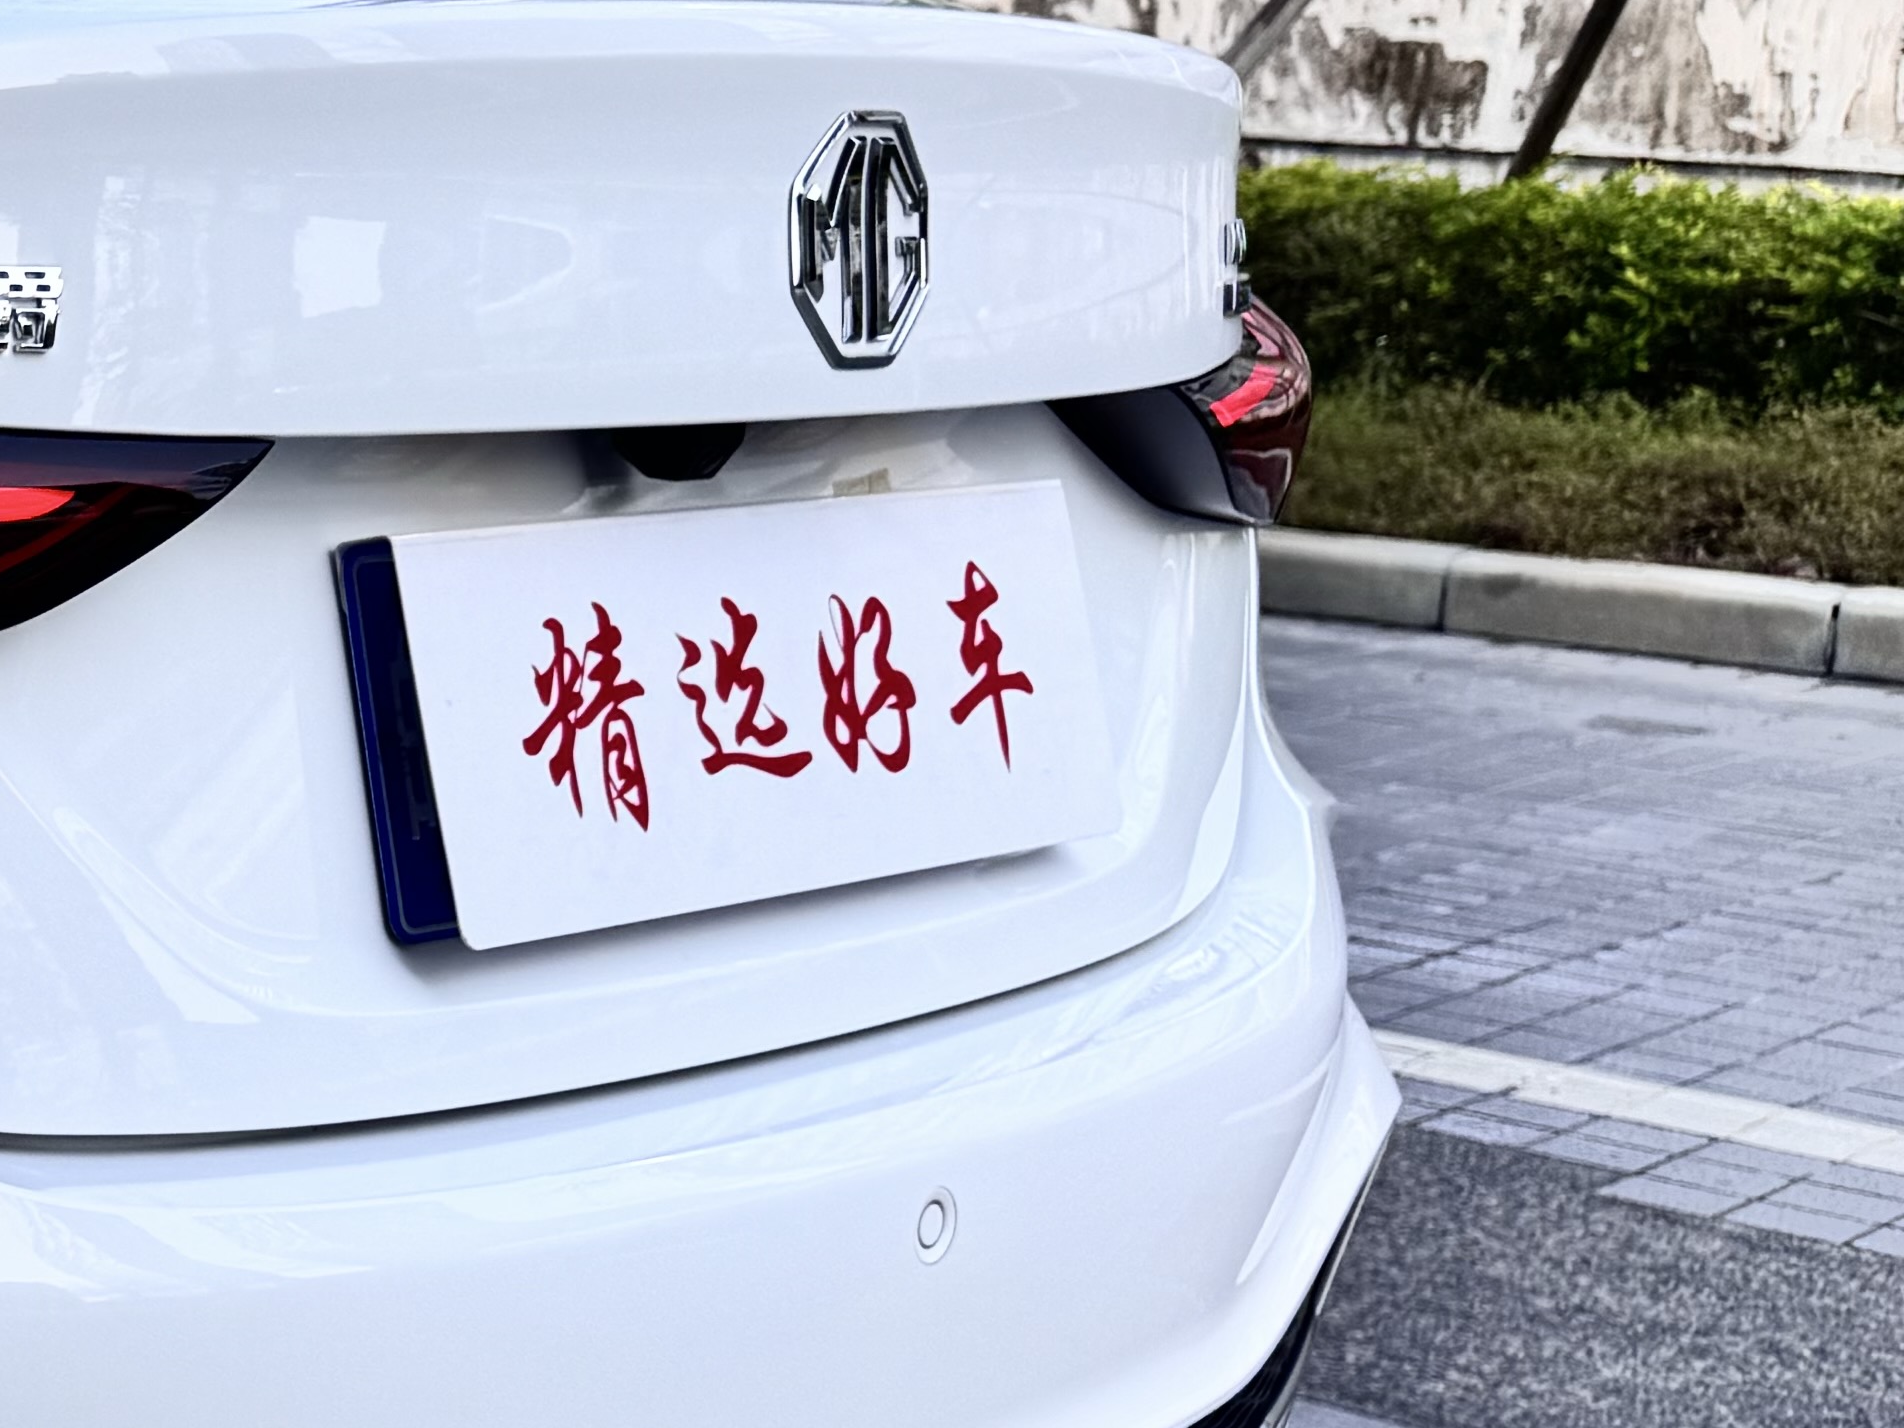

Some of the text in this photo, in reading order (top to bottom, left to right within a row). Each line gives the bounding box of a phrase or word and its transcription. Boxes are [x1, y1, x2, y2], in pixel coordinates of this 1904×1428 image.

[797, 128, 928, 348] MG
[522, 561, 1034, 833] 精选好车
